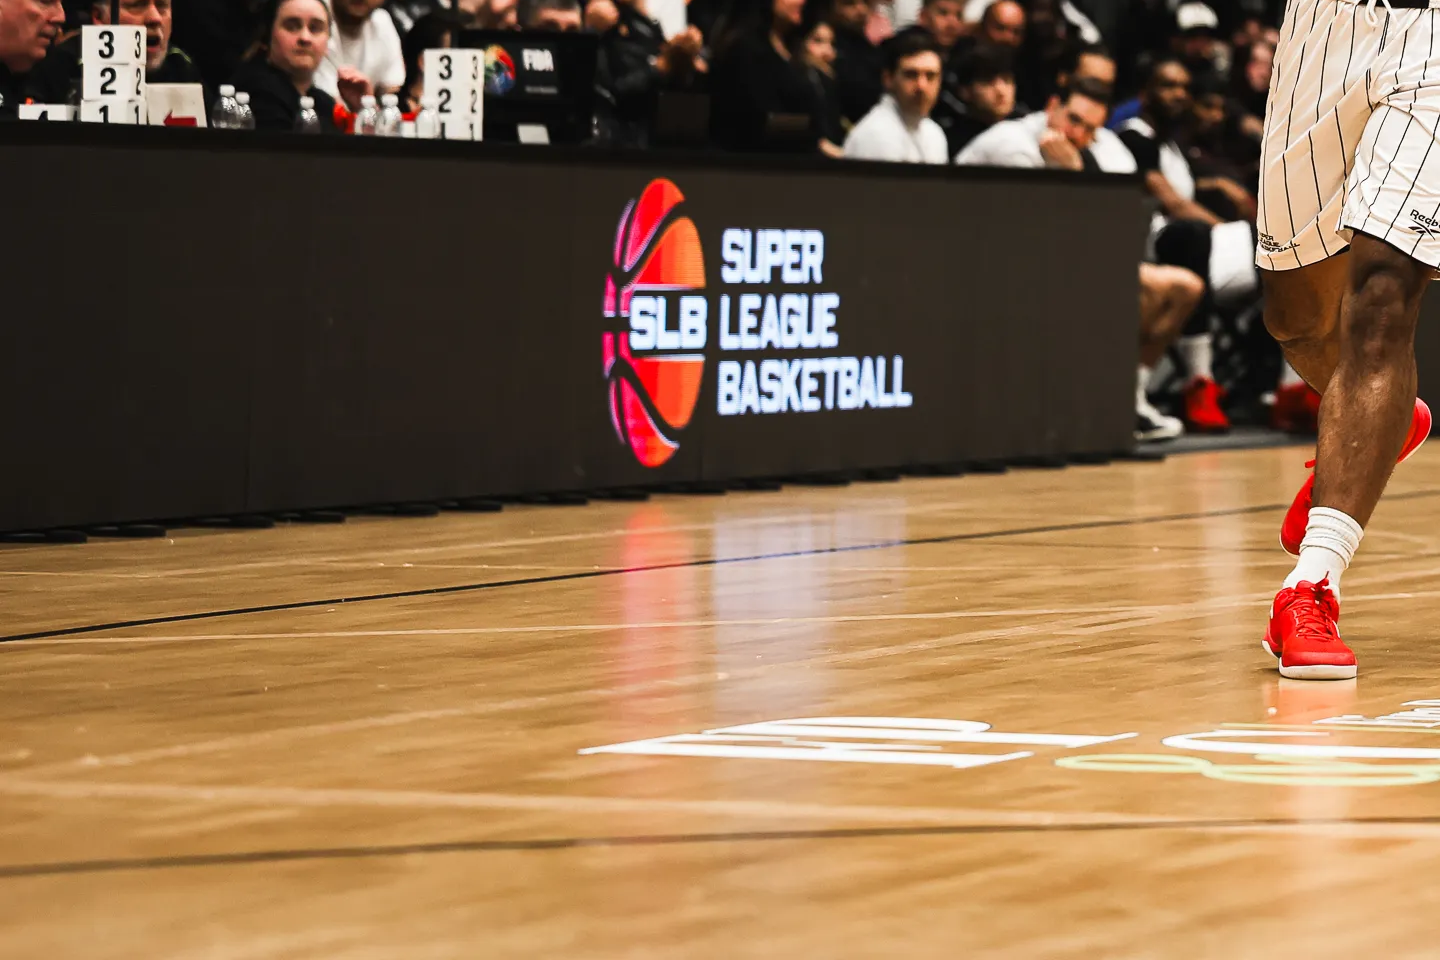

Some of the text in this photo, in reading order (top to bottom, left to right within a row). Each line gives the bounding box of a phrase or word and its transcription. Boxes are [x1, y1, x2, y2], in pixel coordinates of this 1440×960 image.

[98, 30, 115, 59] 3
[134, 31, 141, 59] 3
[100, 67, 116, 95] 2
[136, 68, 141, 95] 2
[439, 55, 452, 80] 3
[472, 55, 478, 80] 3
[438, 89, 451, 113] 2
[471, 90, 477, 113] 2
[721, 228, 824, 284] SUPER
[628, 295, 708, 350] SLB
[719, 293, 840, 350] LEAGUE
[717, 356, 913, 416] BASKETBALL
